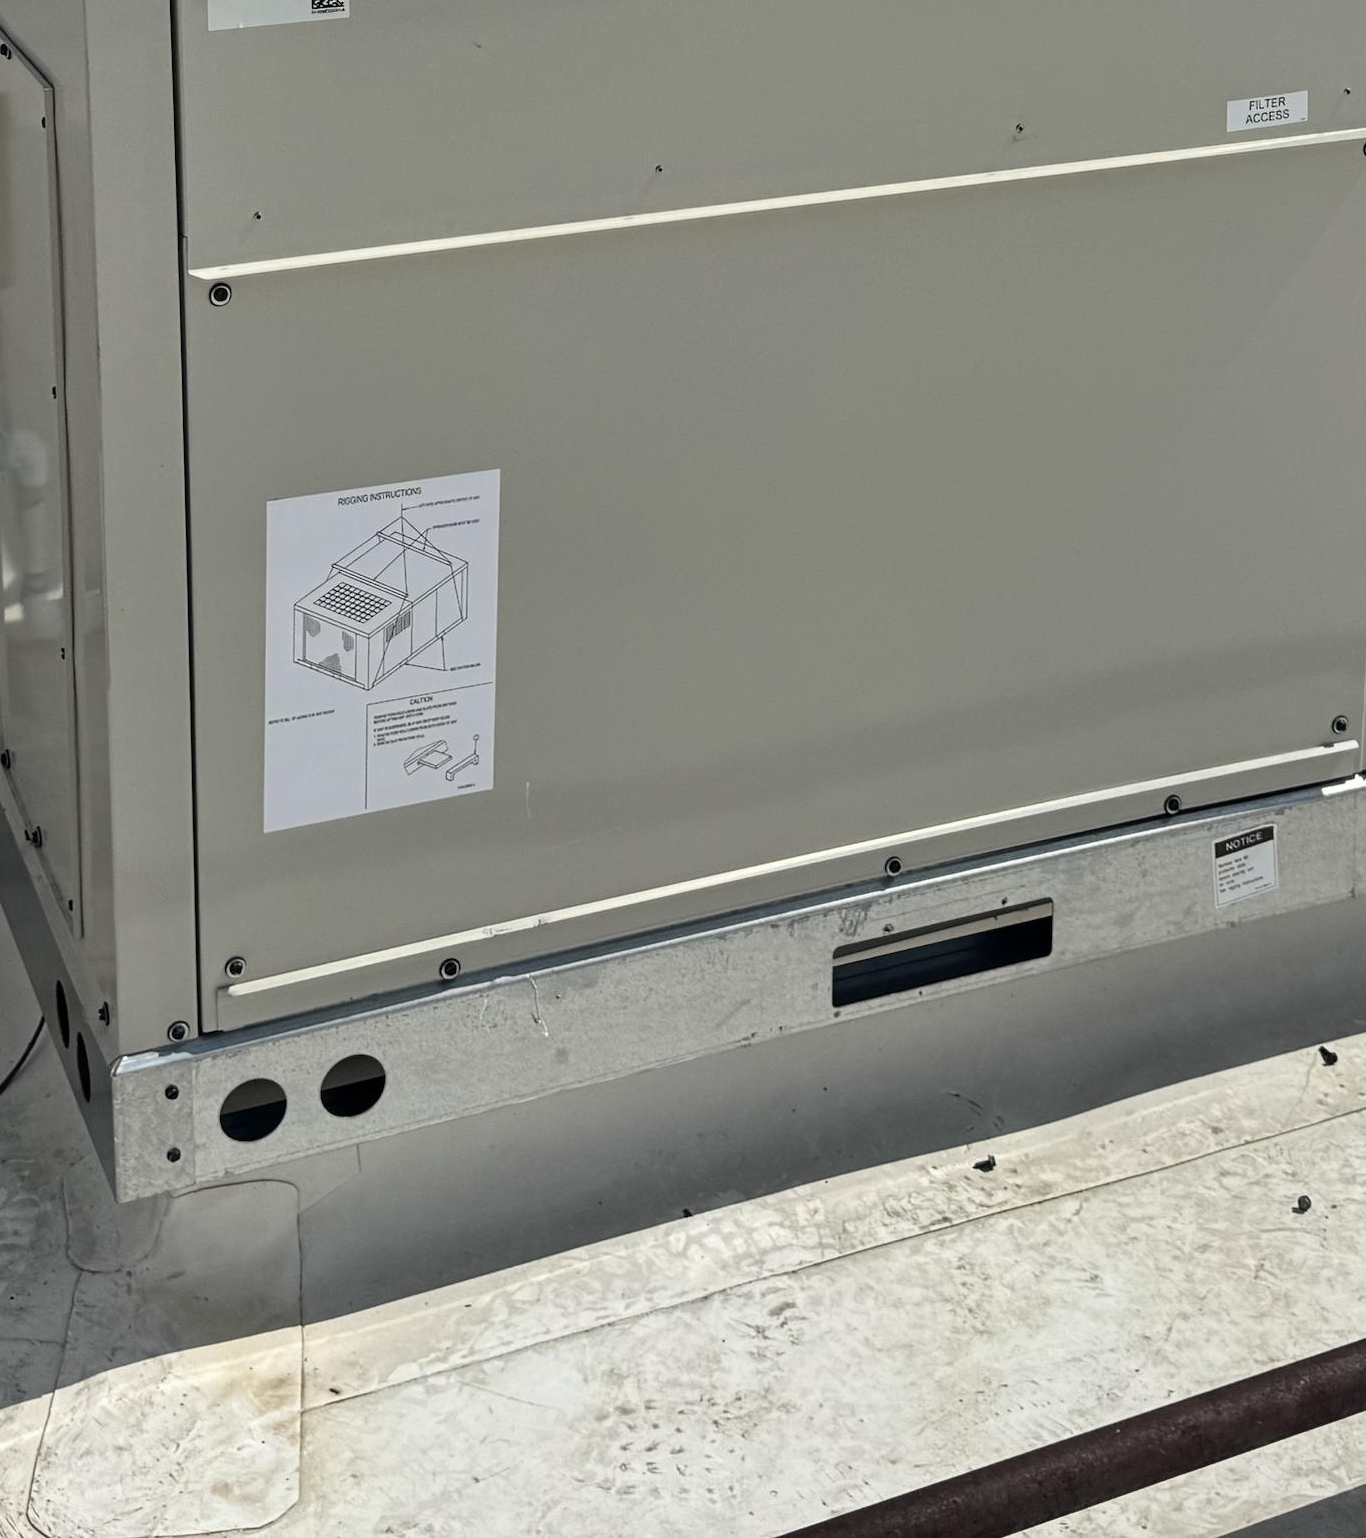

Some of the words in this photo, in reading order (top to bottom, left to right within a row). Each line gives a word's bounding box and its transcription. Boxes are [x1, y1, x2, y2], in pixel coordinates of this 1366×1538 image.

[1249, 96, 1286, 111] FILTER
[1245, 108, 1290, 124] ACCESS
[337, 493, 369, 506] RIGGING
[369, 486, 422, 502] INSTRUCTIONS
[409, 695, 433, 706] CAUTION
[1225, 831, 1264, 851] NOTICE
